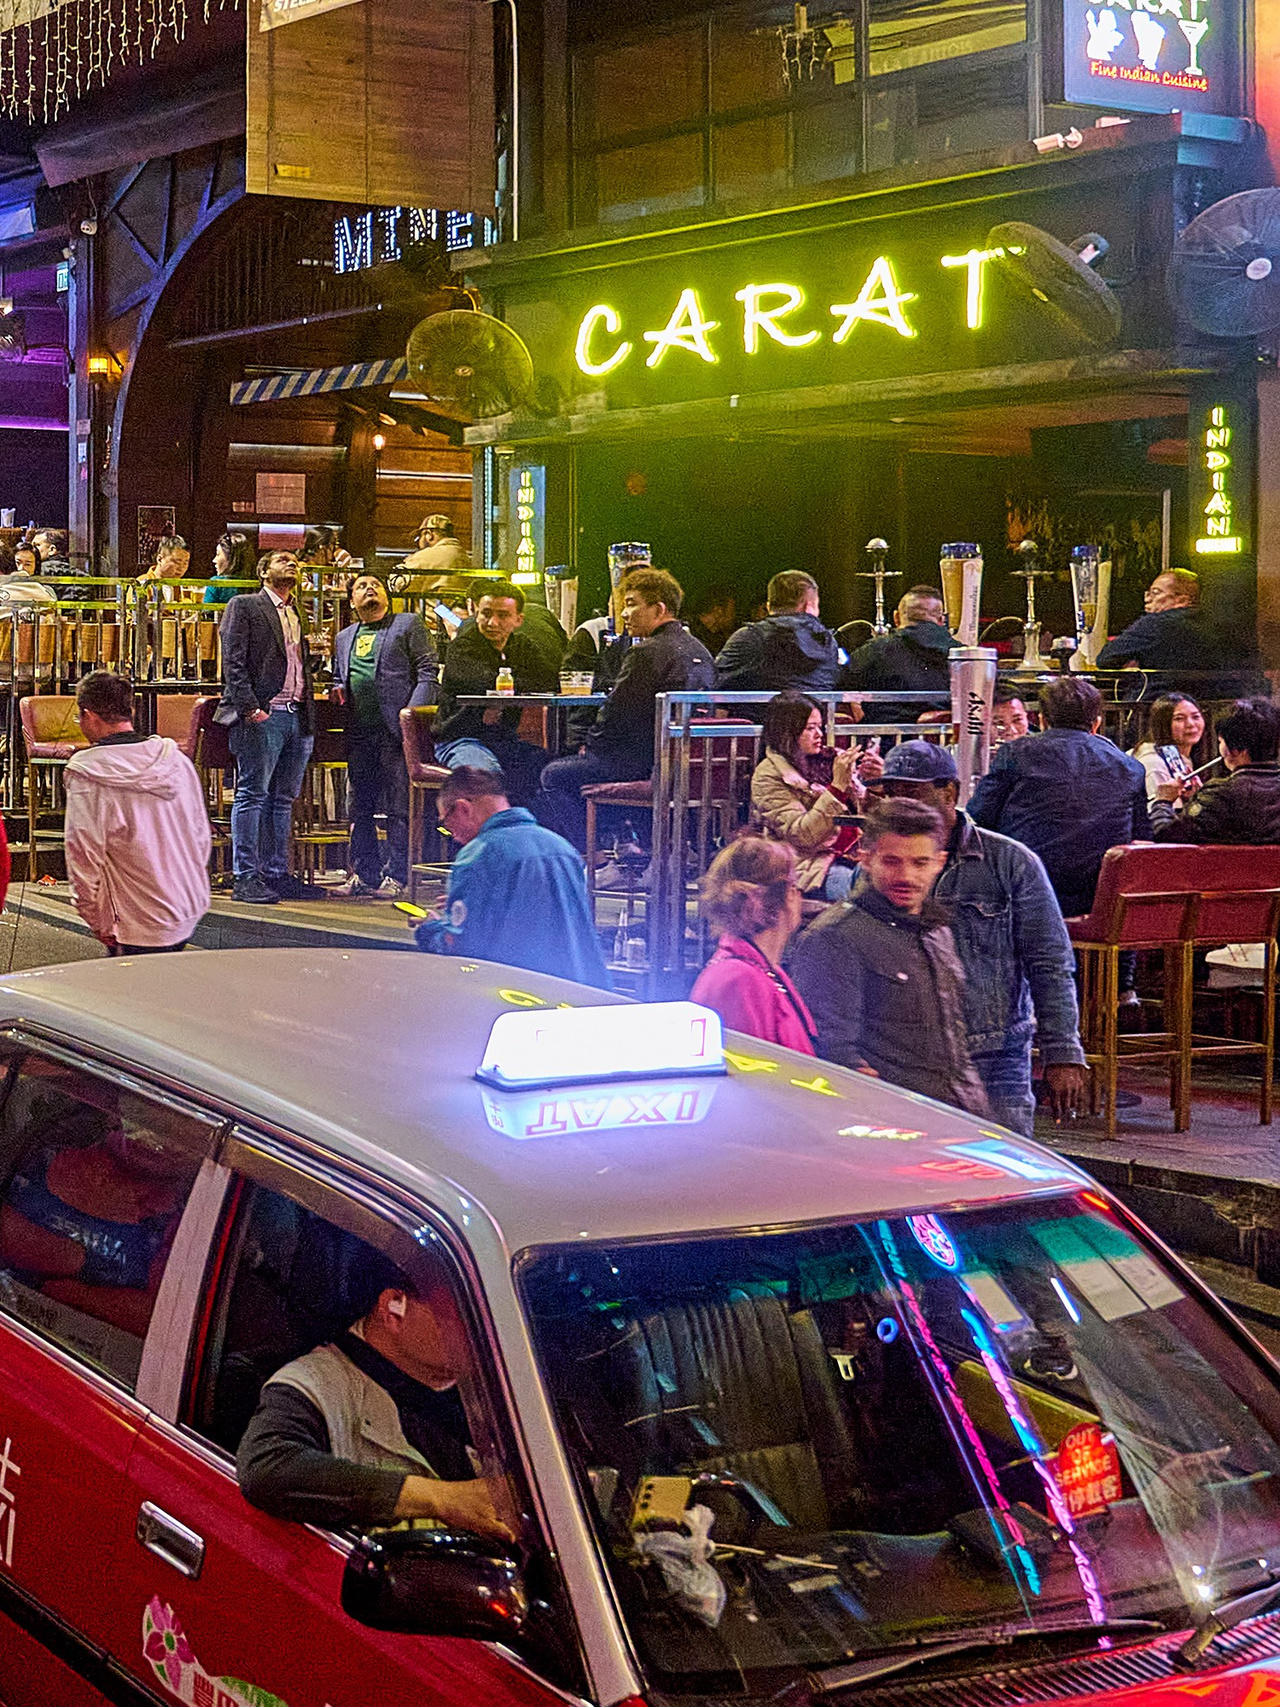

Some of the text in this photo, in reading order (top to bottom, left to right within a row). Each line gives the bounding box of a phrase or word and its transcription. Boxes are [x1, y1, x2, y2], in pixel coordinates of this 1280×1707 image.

[1090, 60, 1208, 92] Fine Indian Cuisine
[334, 205, 499, 275] MINE
[573, 246, 1028, 377] CARAT
[1204, 406, 1232, 536] INDIAN
[516, 471, 536, 572] INDIAN
[1065, 1427, 1096, 1449] OUT
[1071, 1445, 1092, 1465] OF
